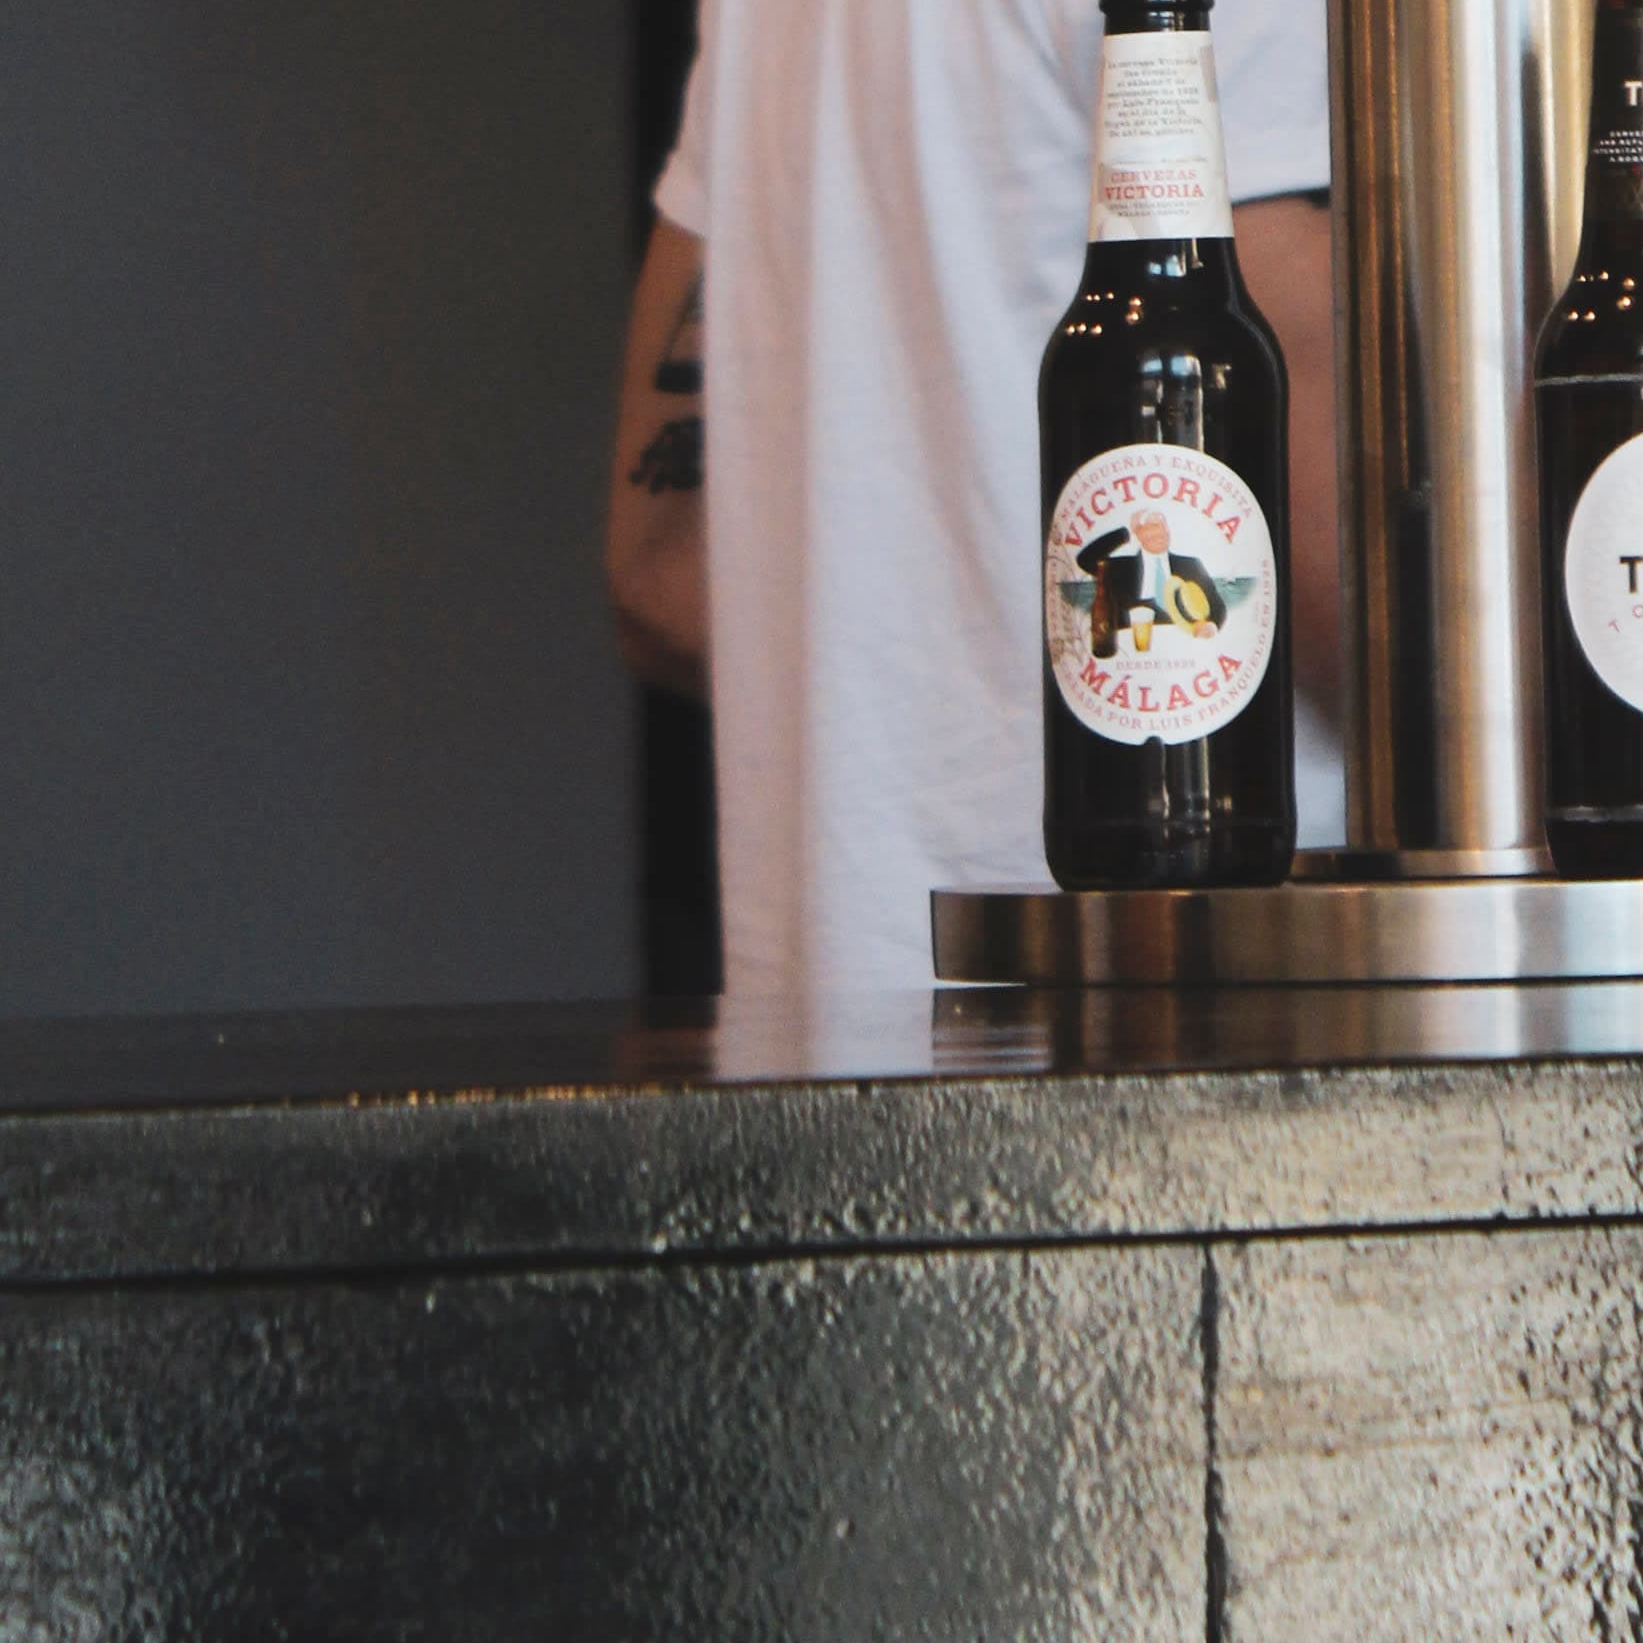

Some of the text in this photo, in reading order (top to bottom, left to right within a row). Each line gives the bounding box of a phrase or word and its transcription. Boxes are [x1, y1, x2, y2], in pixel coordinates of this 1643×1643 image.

[1104, 184, 1205, 202] VICTORIA
[1063, 472, 1243, 549] VICTORIA
[1079, 652, 1243, 713] MÁLAGA
